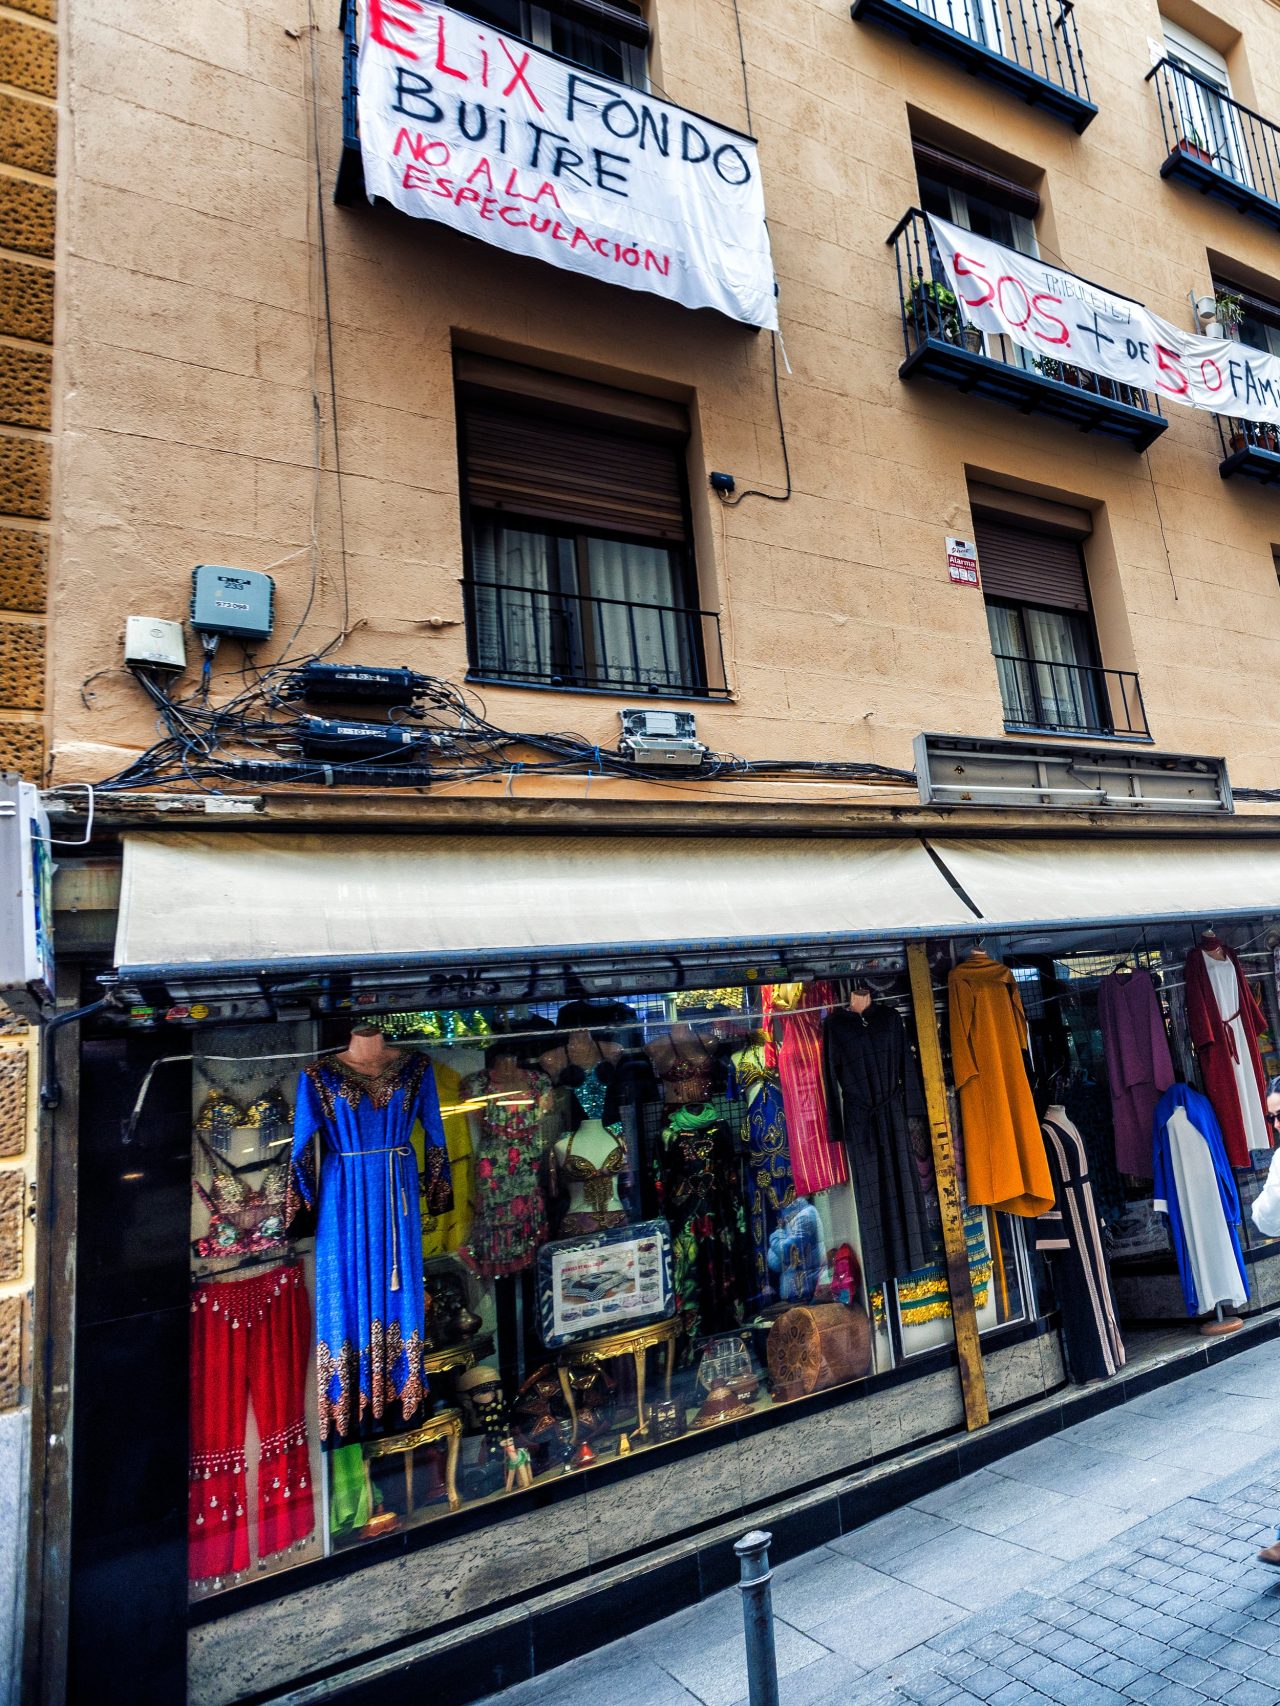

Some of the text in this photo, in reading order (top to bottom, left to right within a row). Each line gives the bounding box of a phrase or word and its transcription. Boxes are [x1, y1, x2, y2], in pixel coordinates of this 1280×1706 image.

[566, 74, 752, 185] FONDO
[392, 127, 561, 209] NO A LA
[402, 164, 670, 276] ESPECULACIÓN
[1126, 340, 1150, 365] DE
[1154, 343, 1223, 396] 50
[217, 576, 251, 585] DIGI
[949, 556, 975, 567] Alarma
